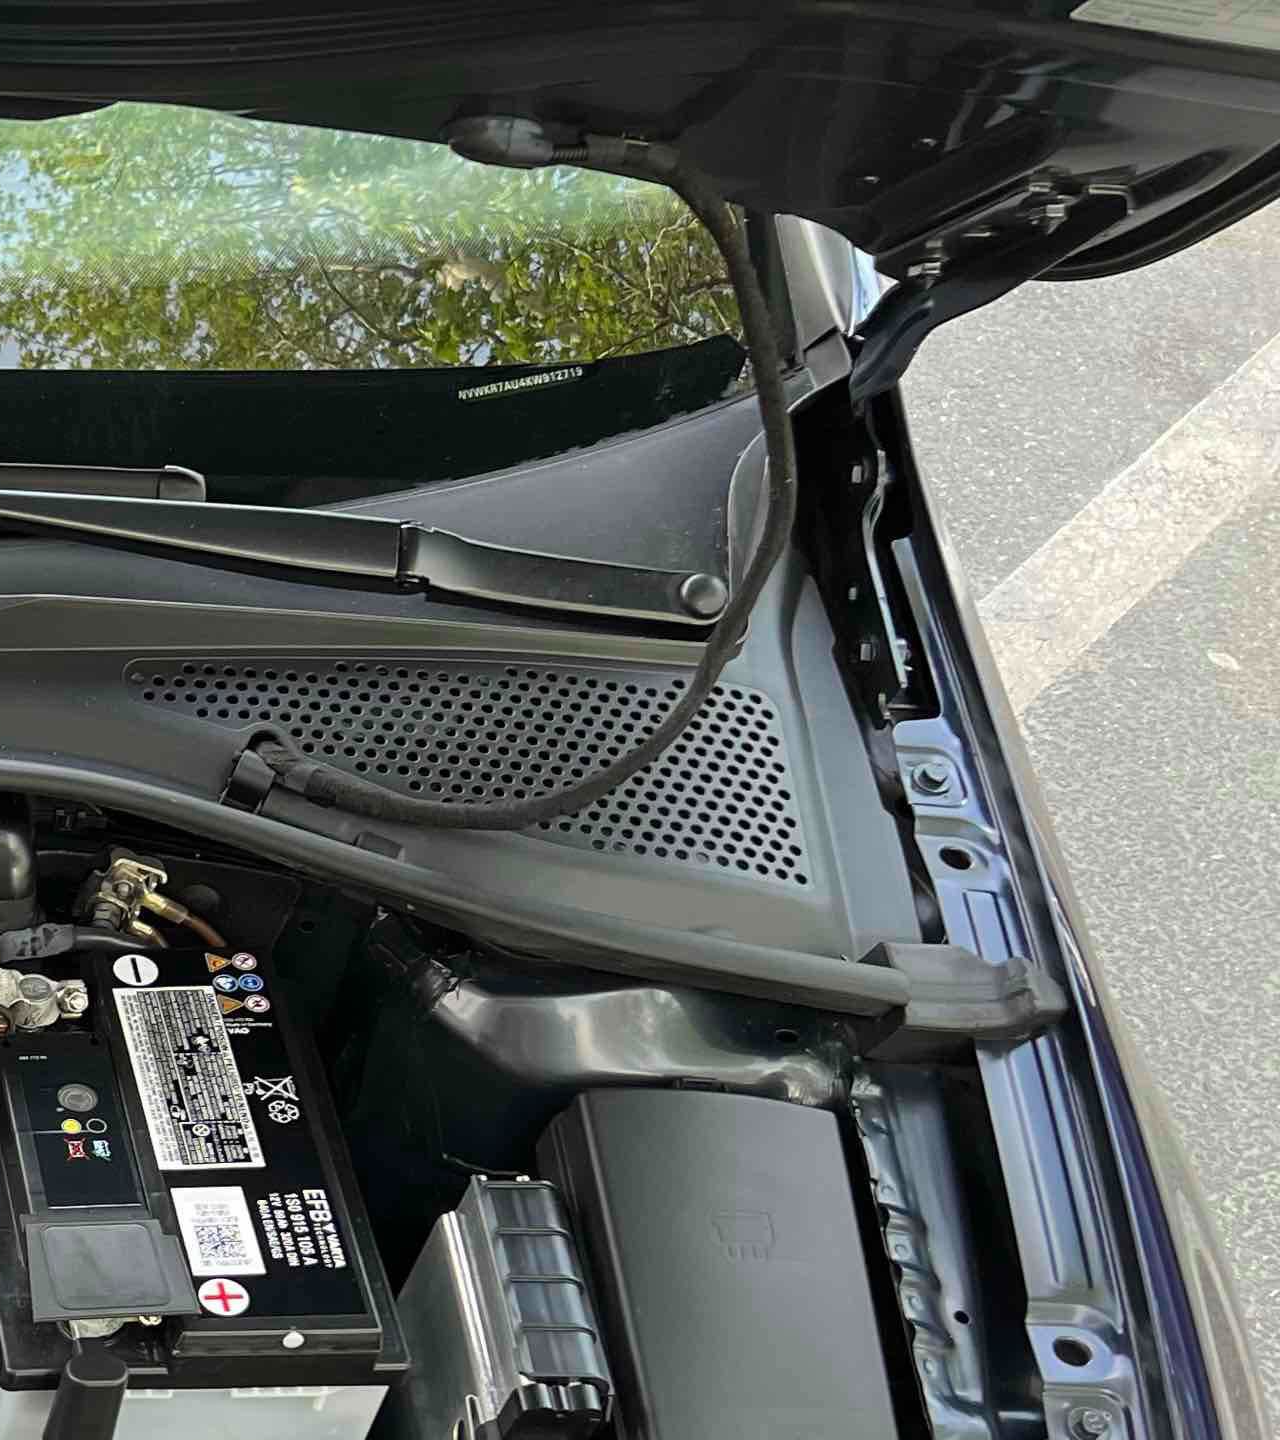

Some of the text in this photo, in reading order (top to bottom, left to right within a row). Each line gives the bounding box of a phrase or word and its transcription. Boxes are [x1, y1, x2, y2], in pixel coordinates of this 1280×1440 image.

[268, 1192, 282, 1206] 12V
[289, 1213, 309, 1233] 915
[301, 1188, 346, 1267] EFB VARTA
[296, 1235, 315, 1255] 105
[312, 1222, 332, 1268] TECHNOLOGY
[301, 1257, 318, 1265] A
